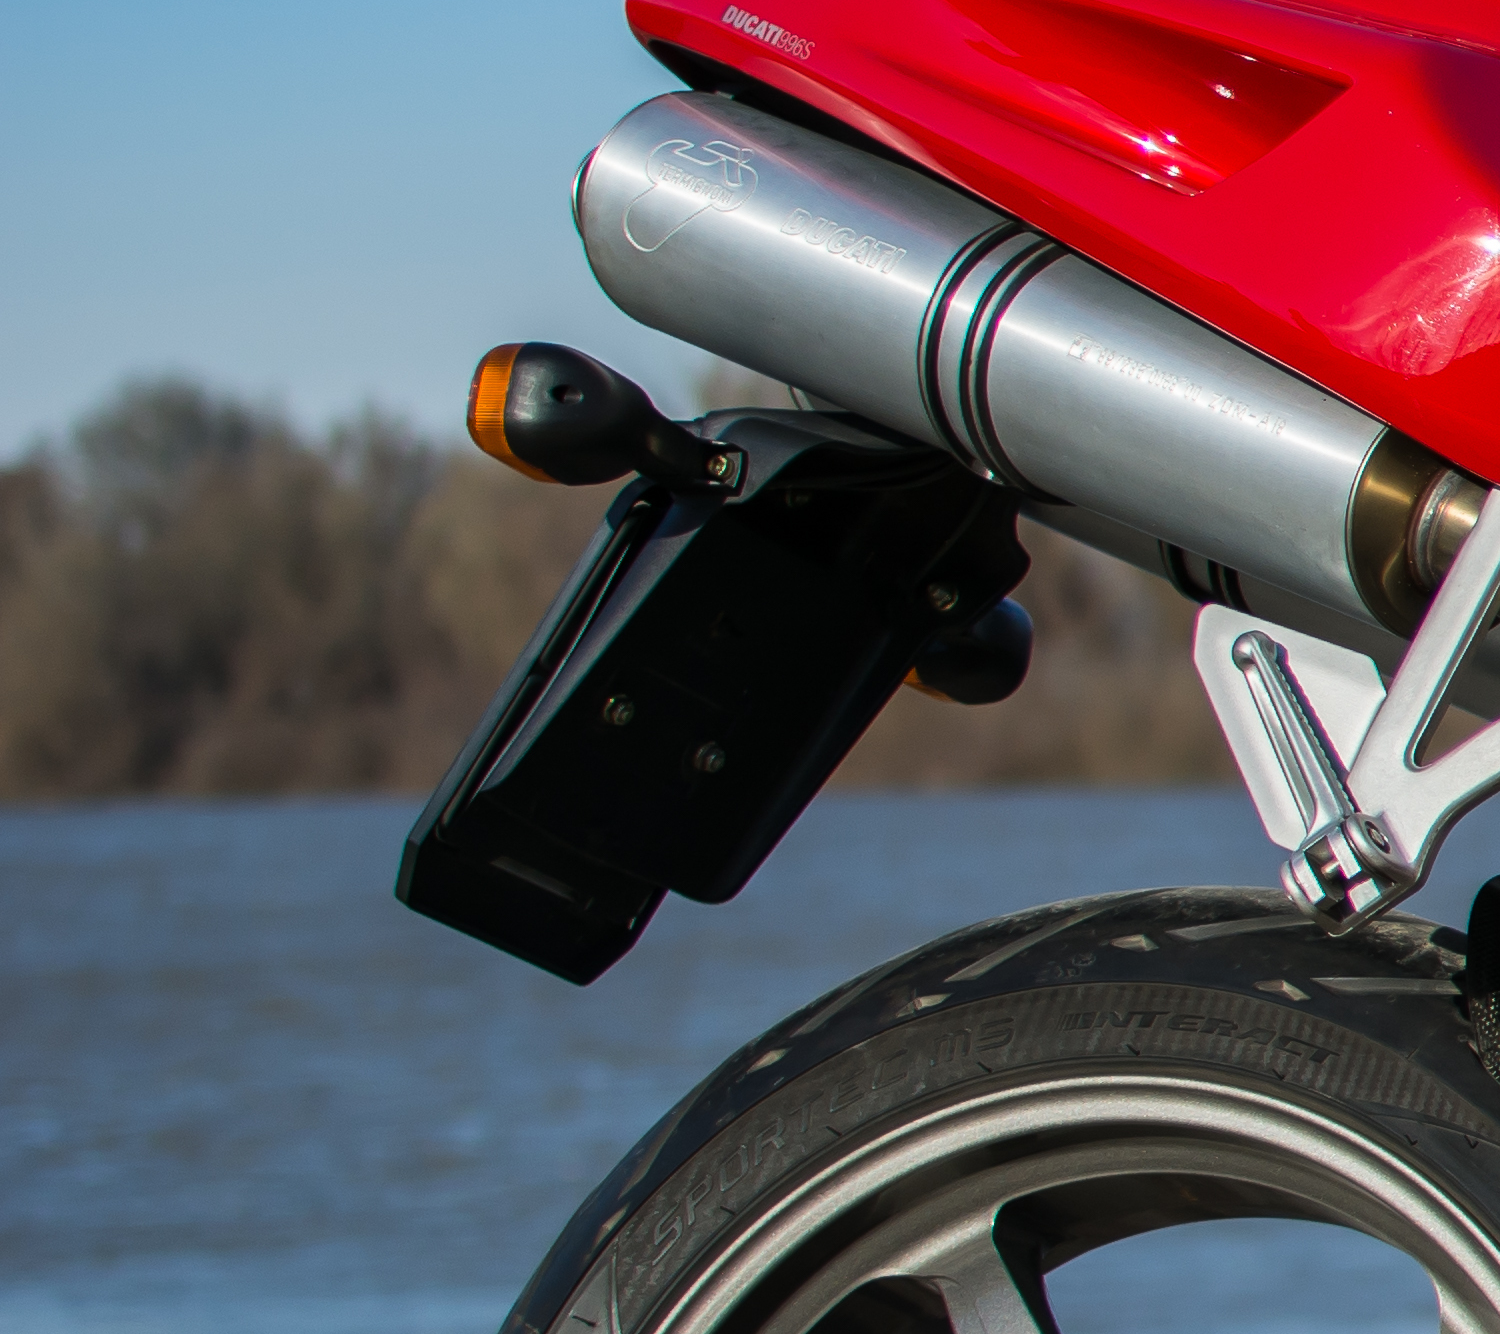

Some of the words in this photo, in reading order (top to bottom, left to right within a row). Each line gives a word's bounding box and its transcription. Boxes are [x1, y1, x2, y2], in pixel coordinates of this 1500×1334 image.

[656, 161, 735, 205] TERMIGNONI
[780, 207, 907, 274] DUCATI
[645, 1049, 916, 1265] SPORTEC
